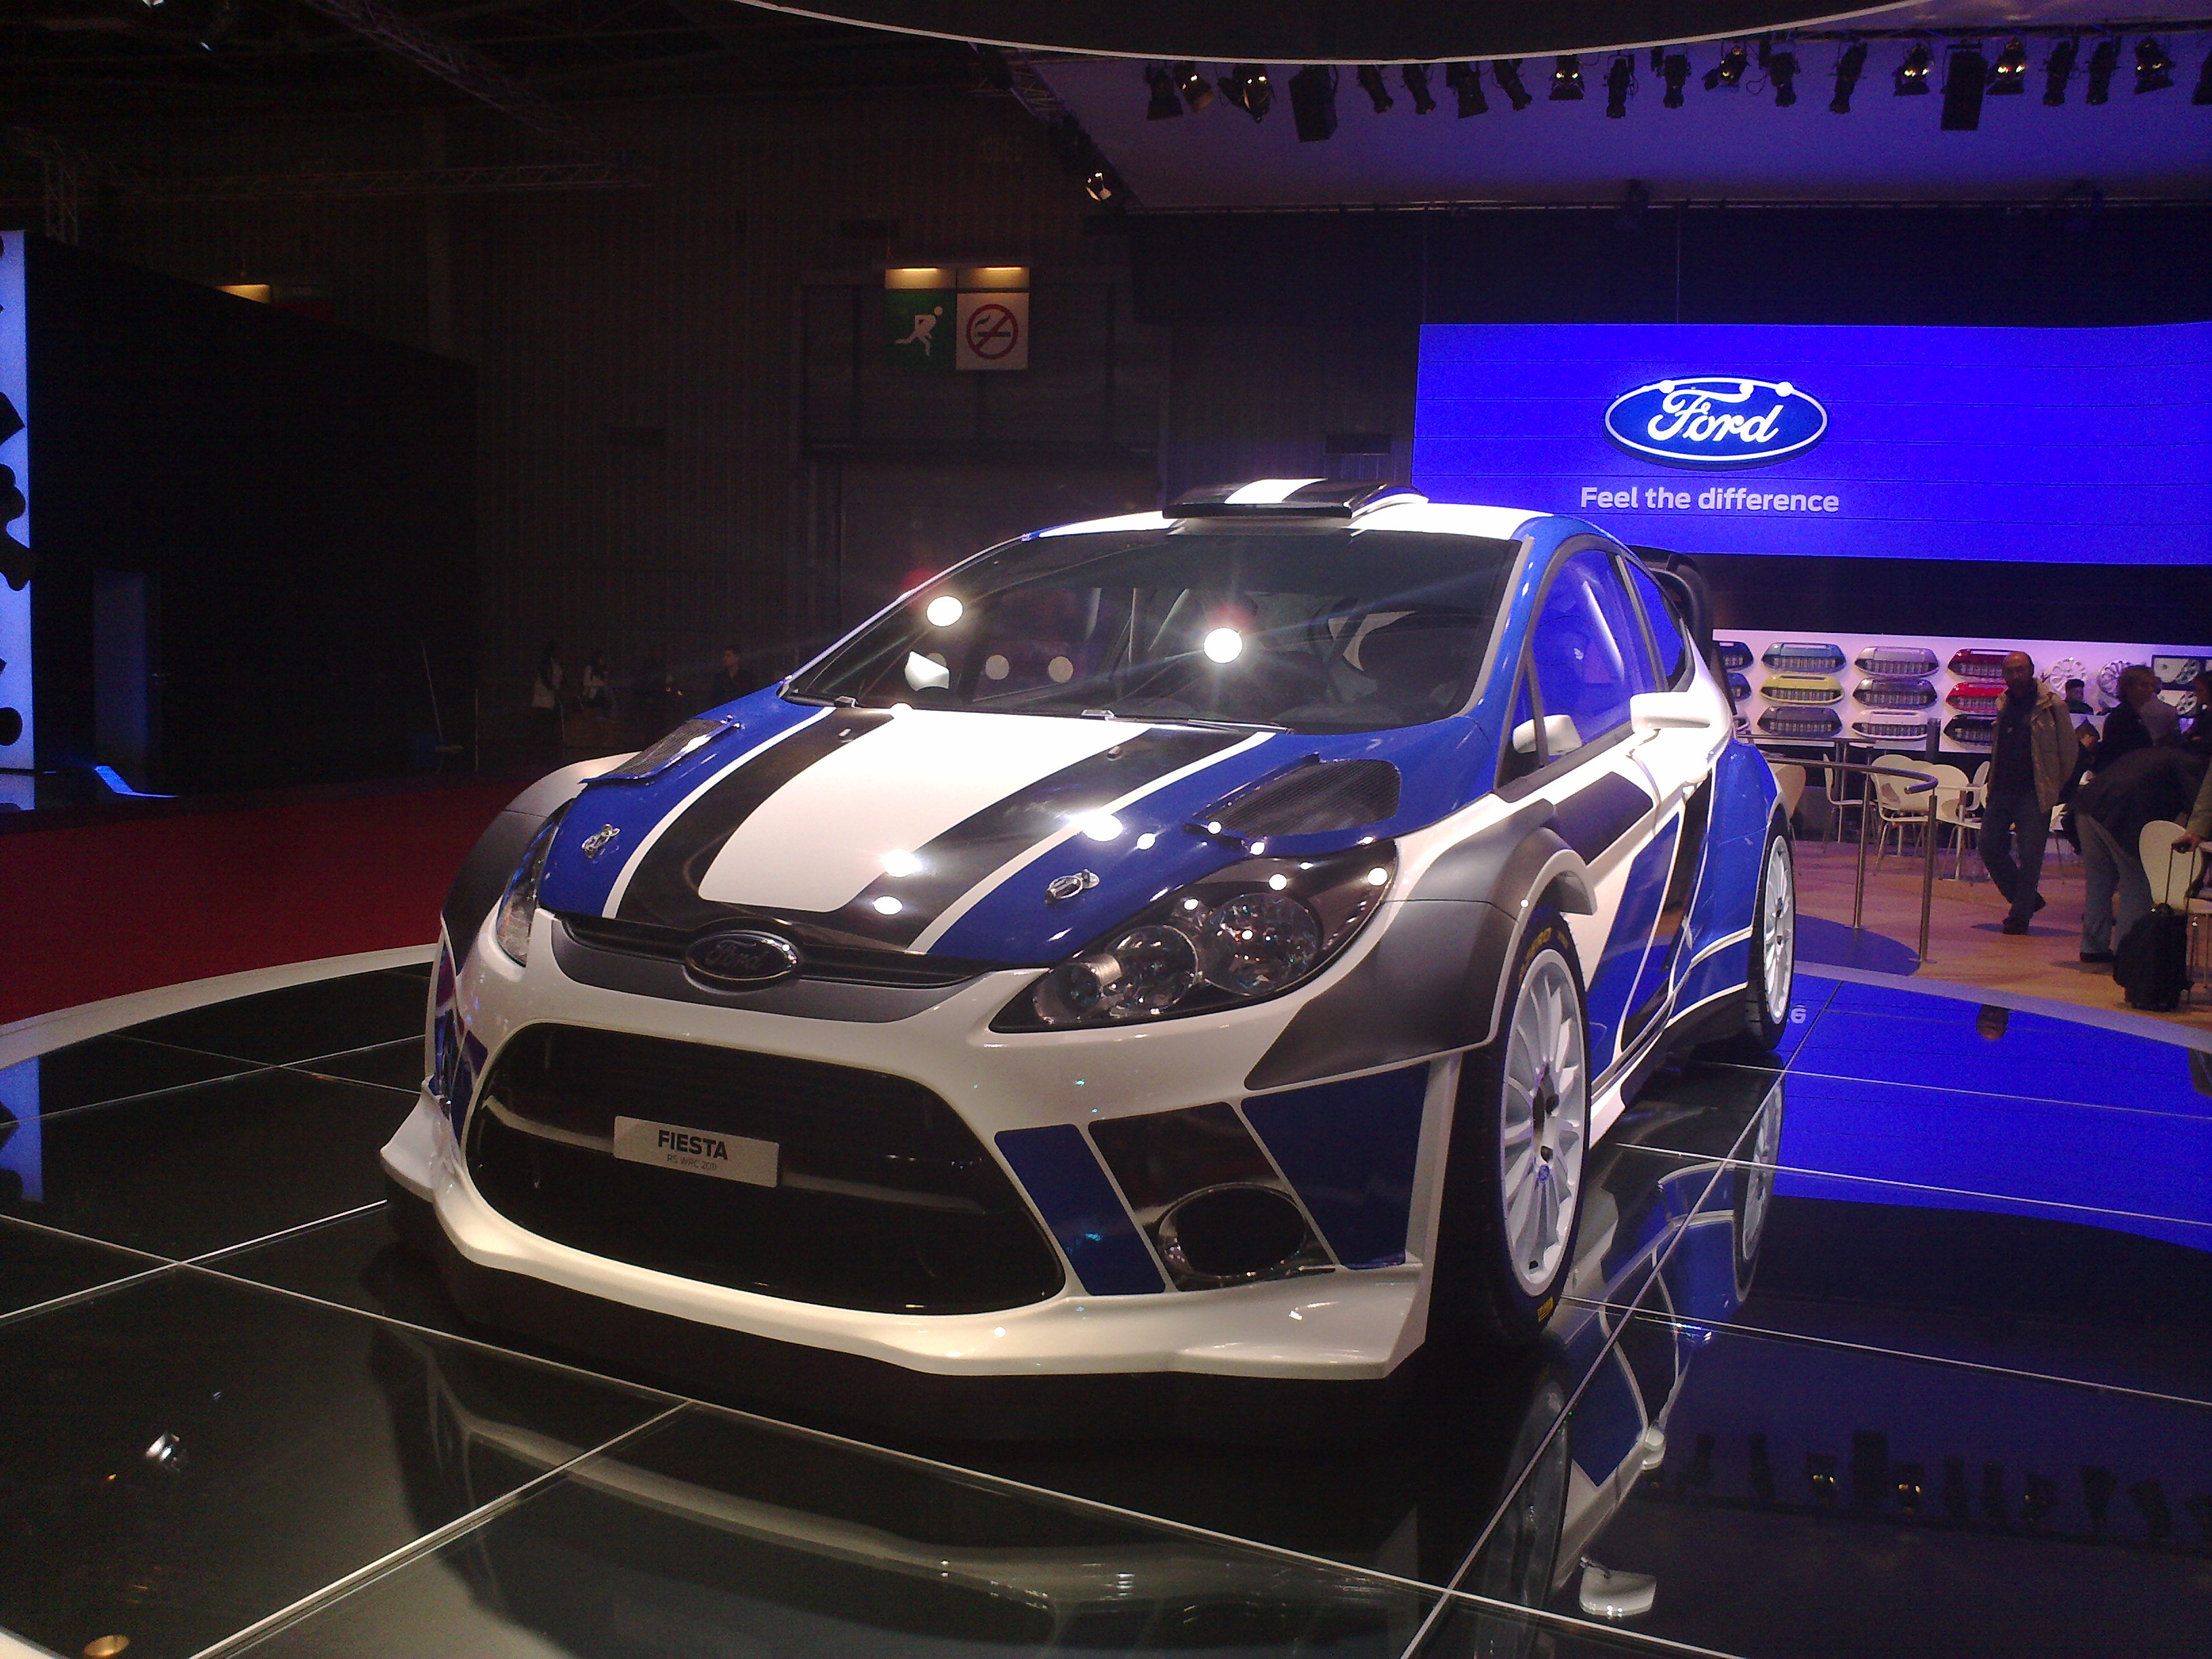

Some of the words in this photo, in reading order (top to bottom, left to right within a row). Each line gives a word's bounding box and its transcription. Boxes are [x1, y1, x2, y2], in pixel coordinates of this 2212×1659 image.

[1648, 384, 1784, 443] Ford
[1580, 487, 1639, 509] Feel
[1645, 487, 1691, 510] the
[1698, 488, 1839, 512] difference
[705, 939, 770, 970] Ford
[658, 1130, 728, 1160] FIESTA
